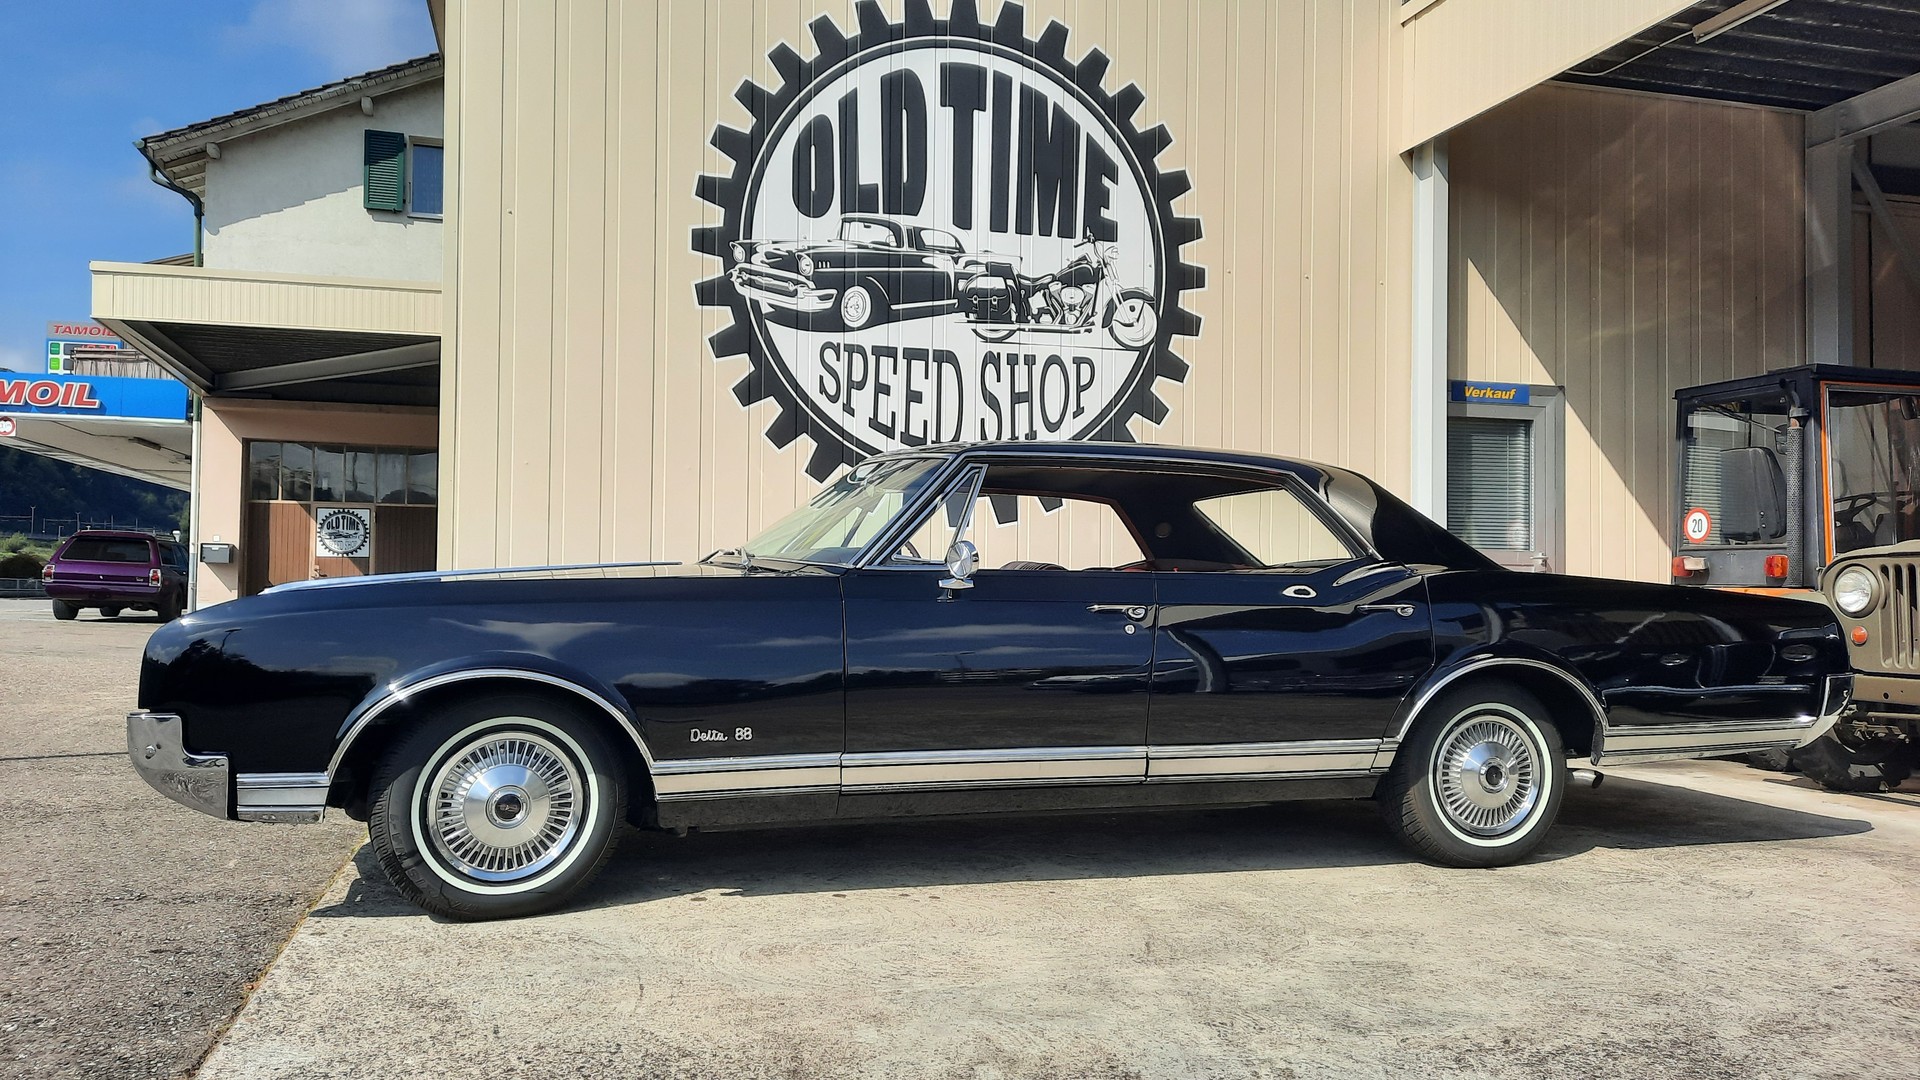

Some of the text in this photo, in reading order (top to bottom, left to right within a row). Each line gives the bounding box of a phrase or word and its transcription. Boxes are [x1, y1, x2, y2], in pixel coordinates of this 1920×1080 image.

[792, 62, 1118, 242] OLD TIME
[819, 341, 1096, 448] SPEED SHOP
[1464, 386, 1517, 400] Verkauf
[326, 515, 360, 530] OLD TIME
[1692, 518, 1702, 533] 20
[690, 727, 753, 742] Delta 88
